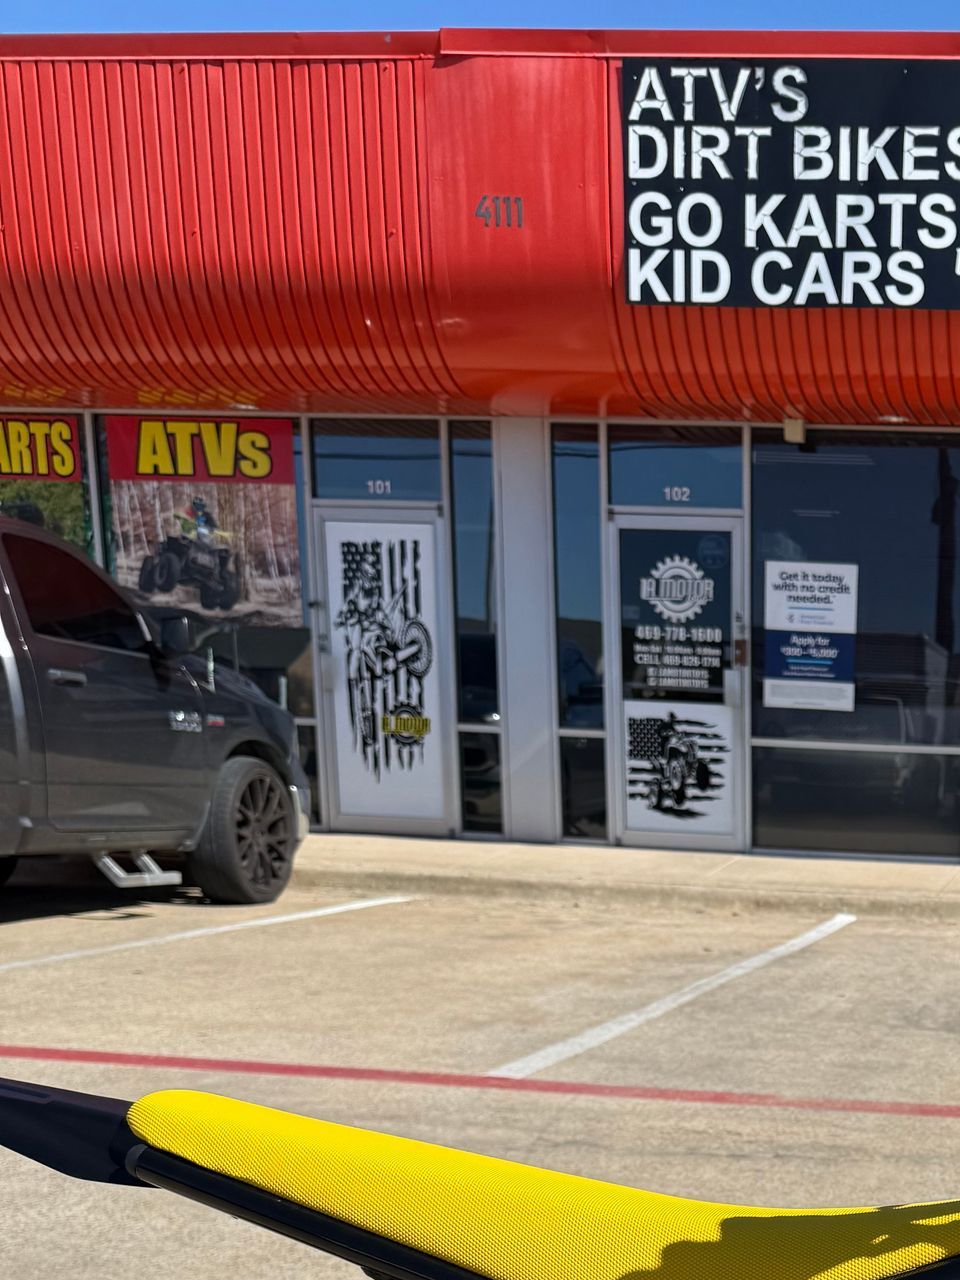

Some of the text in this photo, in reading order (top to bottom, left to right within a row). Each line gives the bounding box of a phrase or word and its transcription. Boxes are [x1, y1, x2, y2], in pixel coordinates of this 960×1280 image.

[628, 66, 808, 122] ATV'S
[628, 126, 772, 180] DIRT
[475, 195, 523, 228] 4111
[628, 191, 957, 249] GO KARTS
[628, 248, 925, 306] KID CARS
[137, 420, 272, 478] ATVs
[367, 480, 391, 494] 101
[663, 487, 690, 501] 102
[772, 582, 798, 592] with
[818, 584, 850, 594] credit
[779, 571, 845, 584] Get it today
